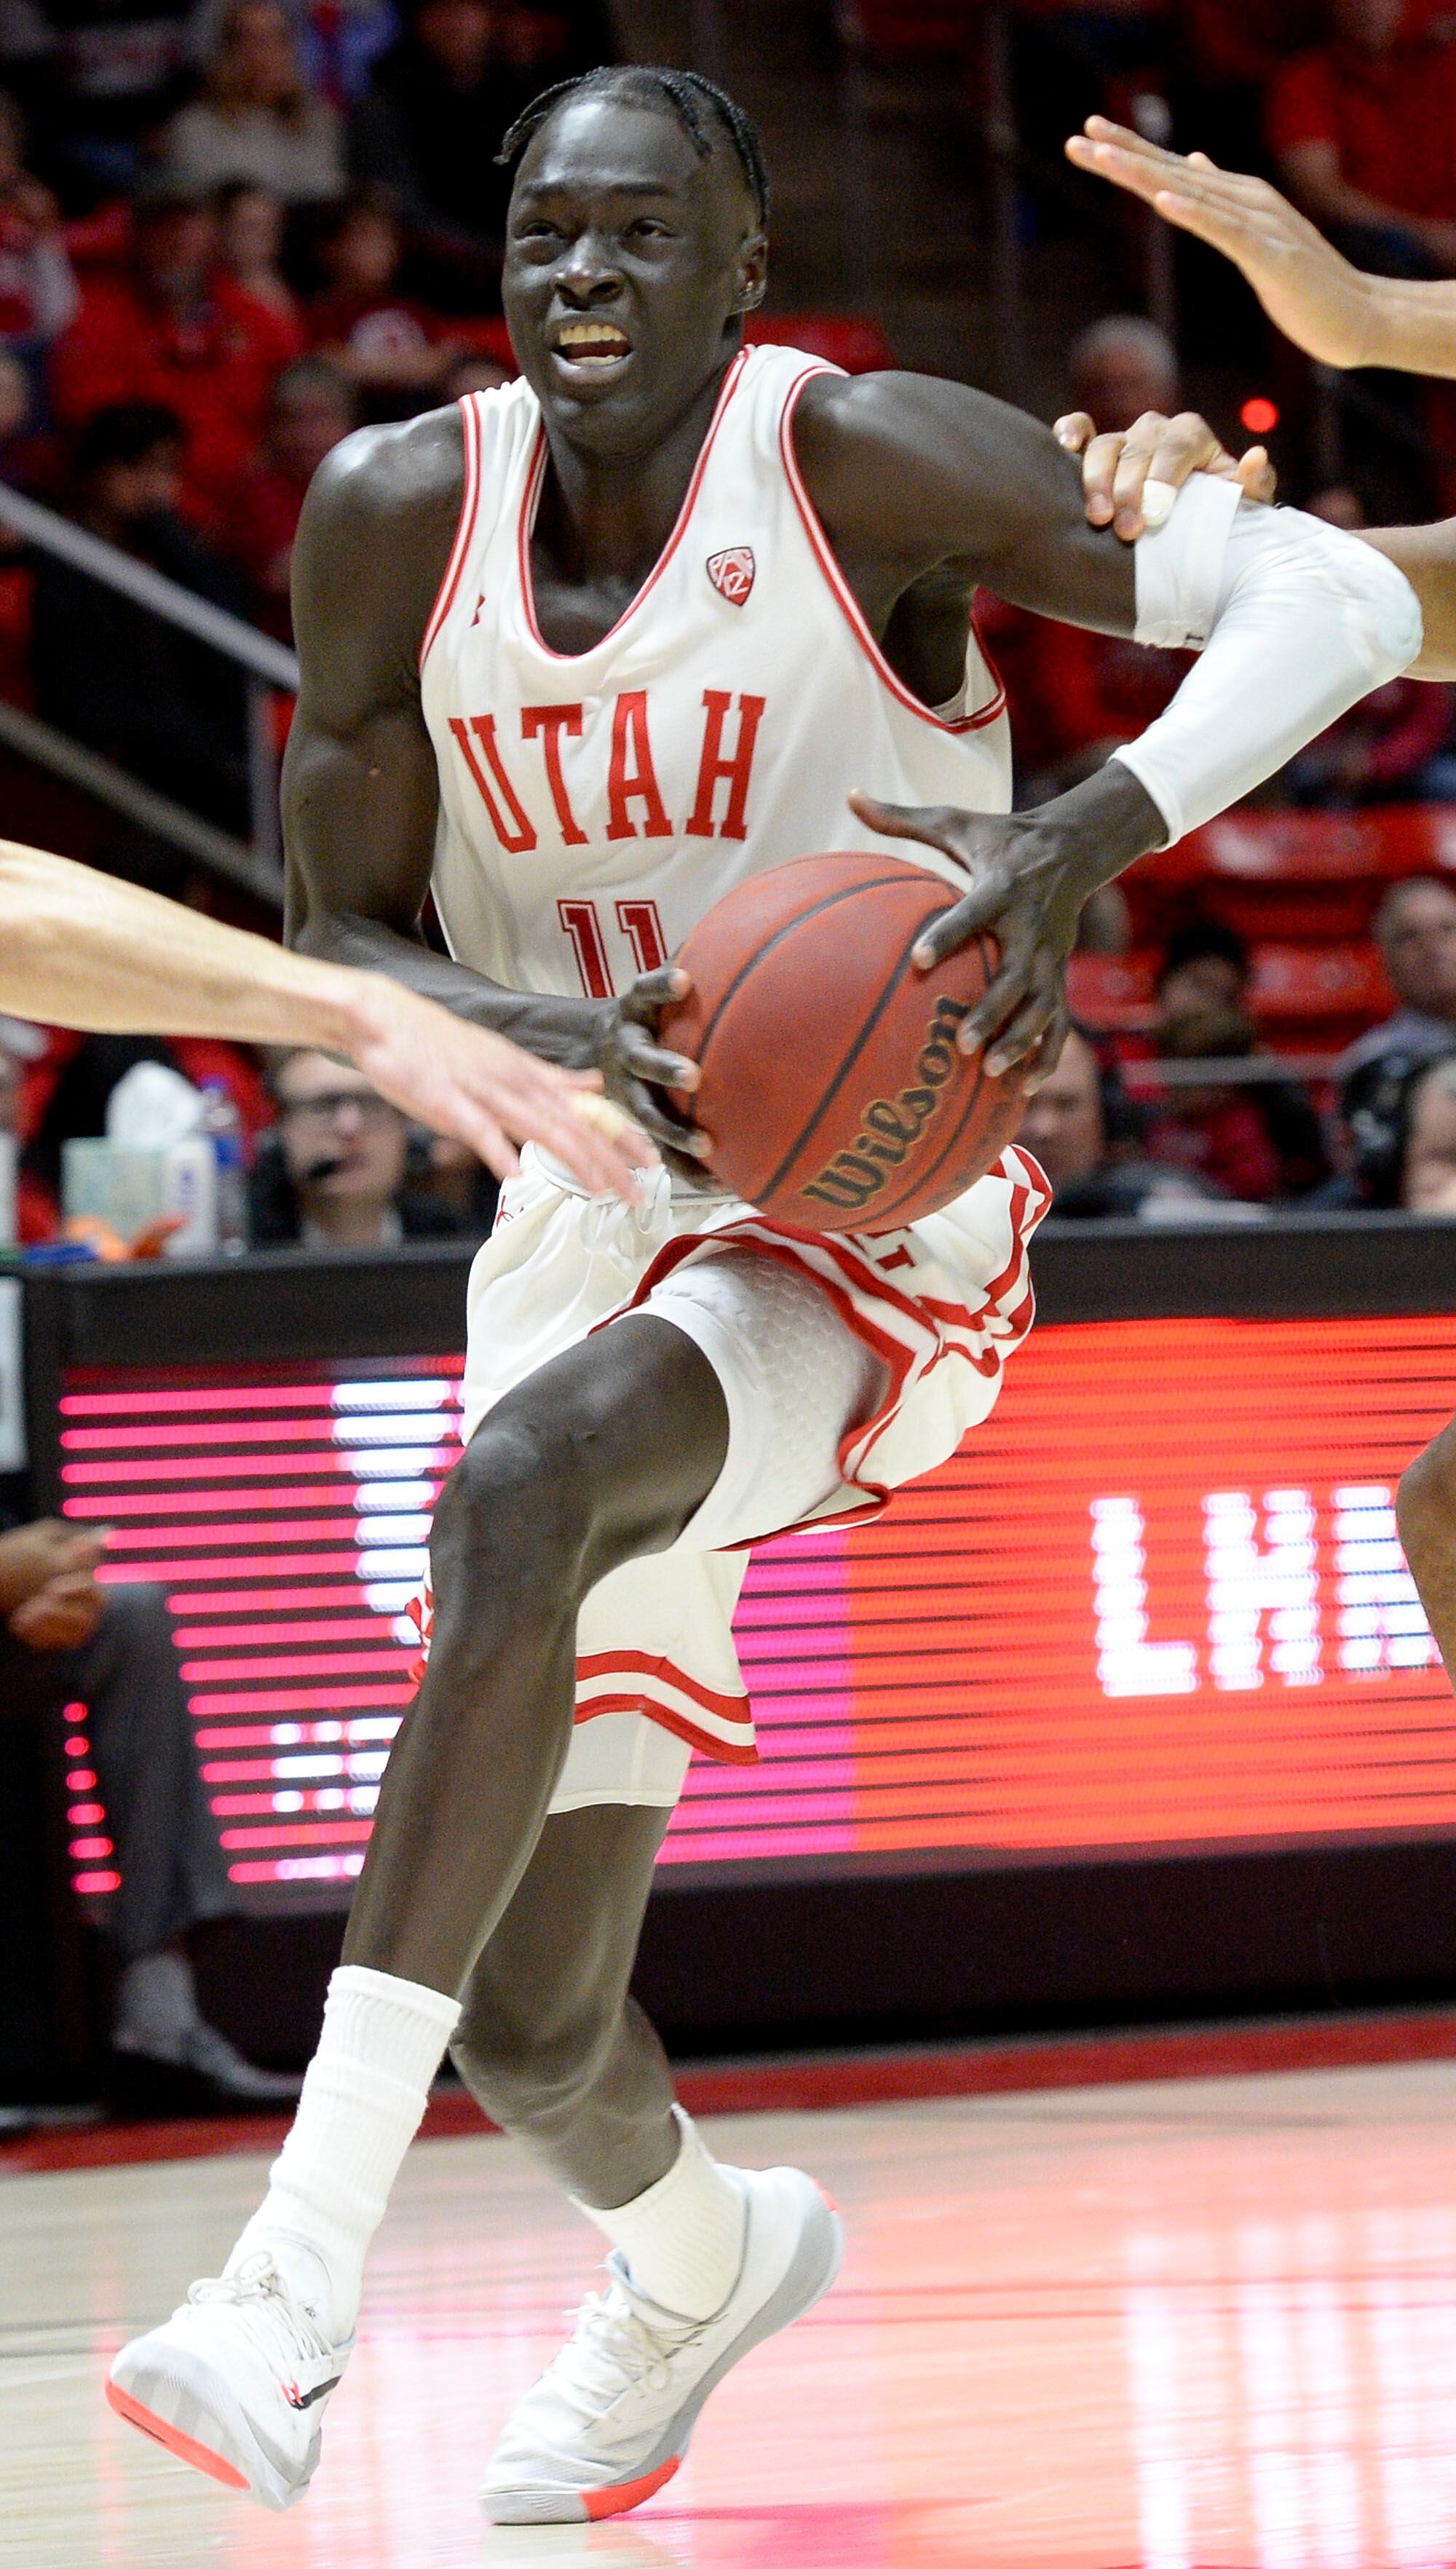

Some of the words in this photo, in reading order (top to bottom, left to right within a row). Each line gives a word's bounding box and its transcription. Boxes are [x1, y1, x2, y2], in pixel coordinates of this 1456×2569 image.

[448, 689, 766, 853] UTAH
[557, 899, 668, 998] 11
[799, 995, 970, 1209] Wilson
